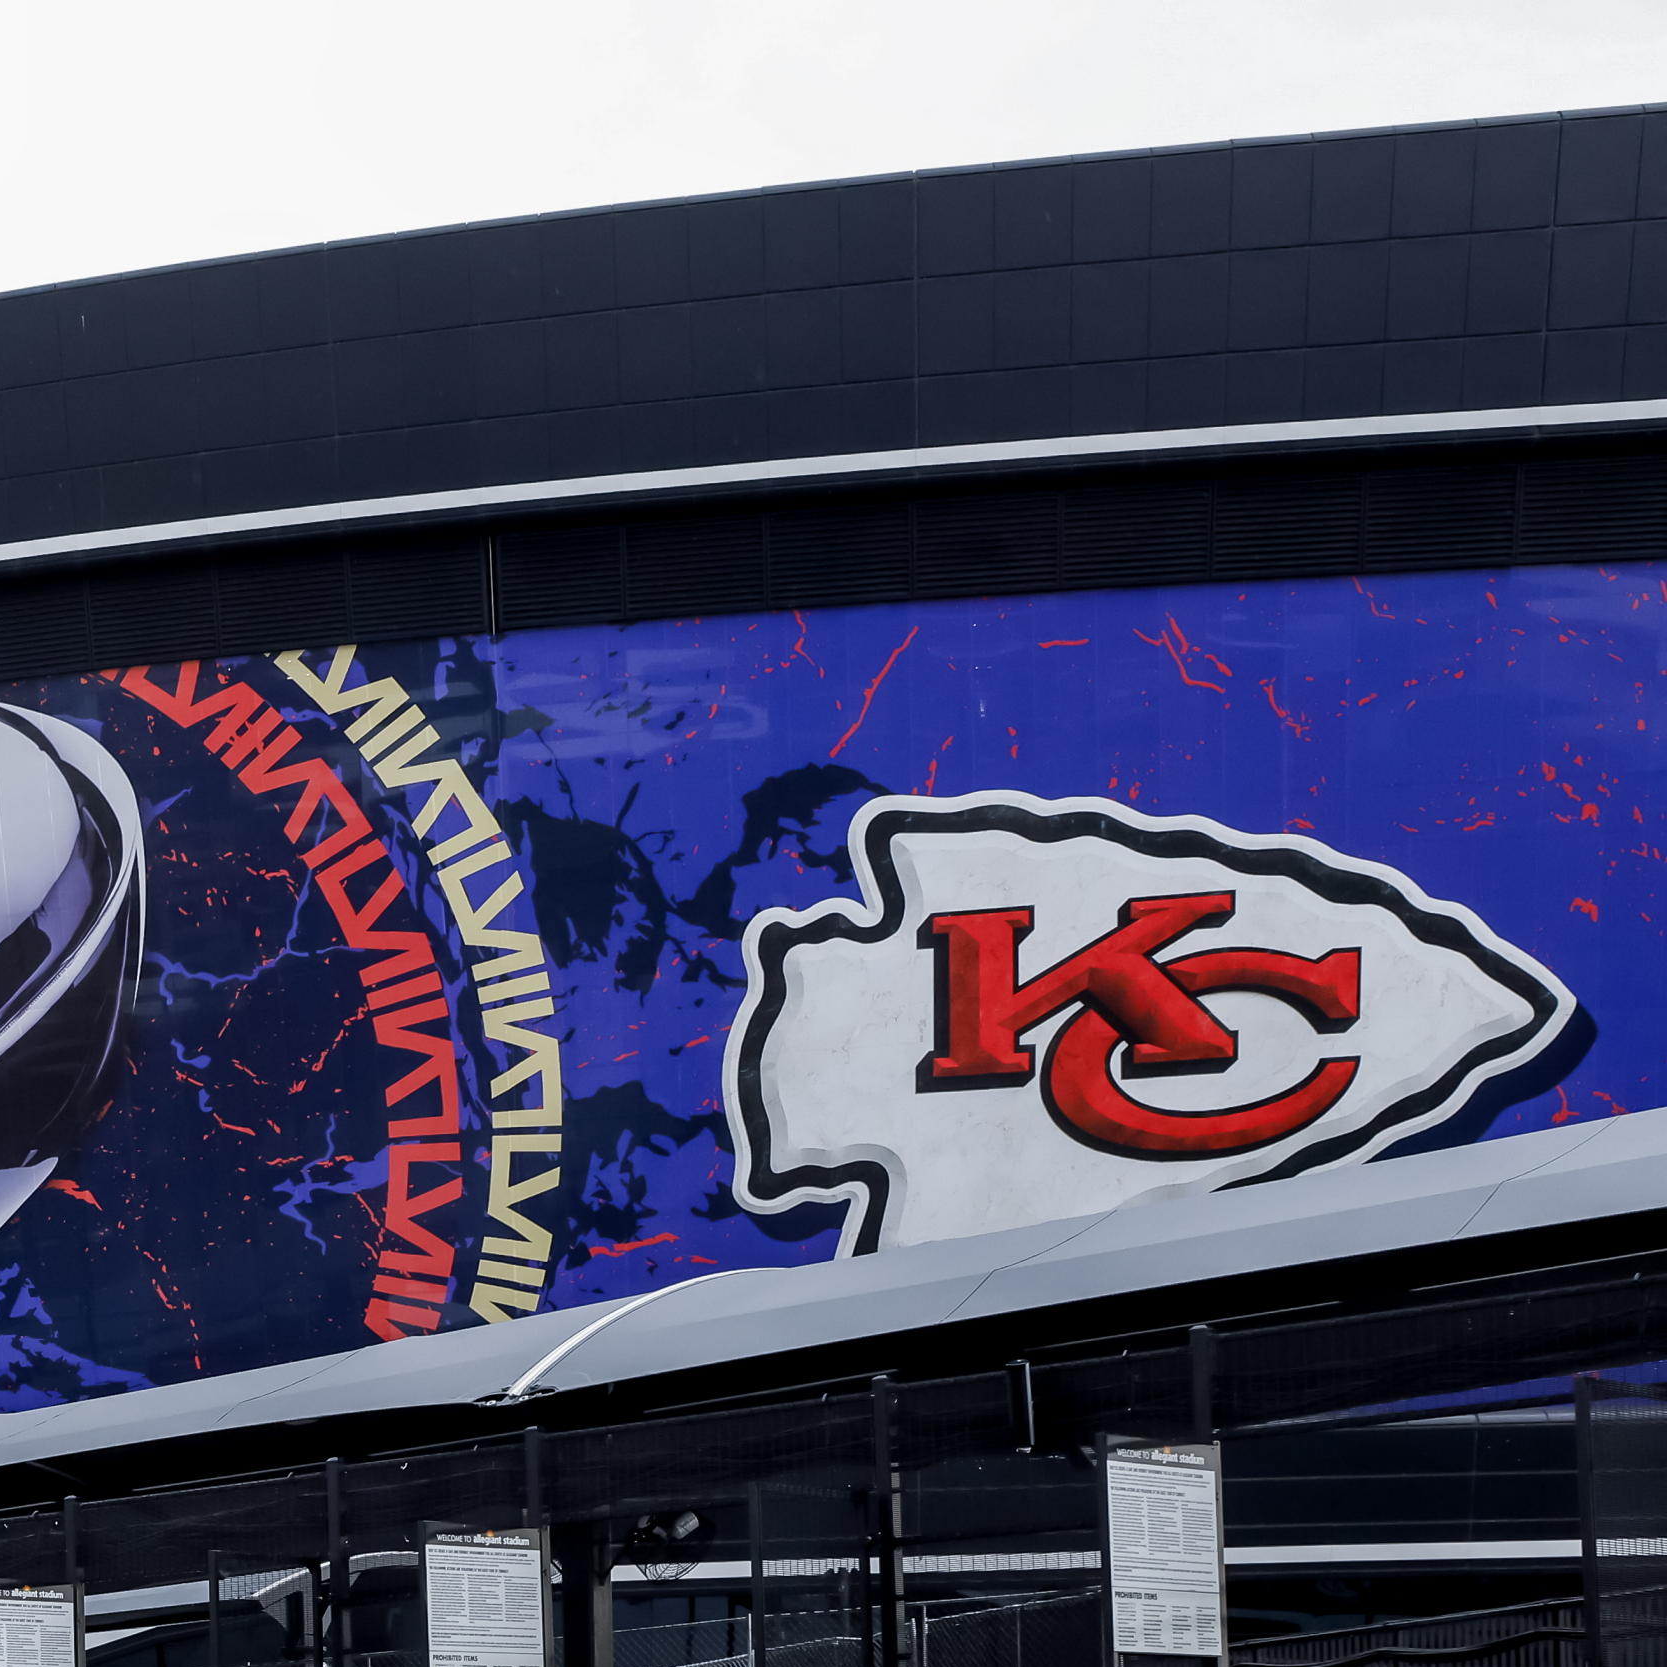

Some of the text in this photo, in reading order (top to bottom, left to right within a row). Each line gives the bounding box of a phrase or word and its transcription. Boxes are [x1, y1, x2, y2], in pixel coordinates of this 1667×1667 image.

[1117, 1448, 1205, 1466] WELCOME TO allegiant stadium
[436, 1534, 530, 1546] WELCOME TO allegiant stadium
[11, 1588, 38, 1600] allegiant
[39, 1590, 64, 1600] stadium
[1115, 1592, 1158, 1601] PROHIBITED ITEMS
